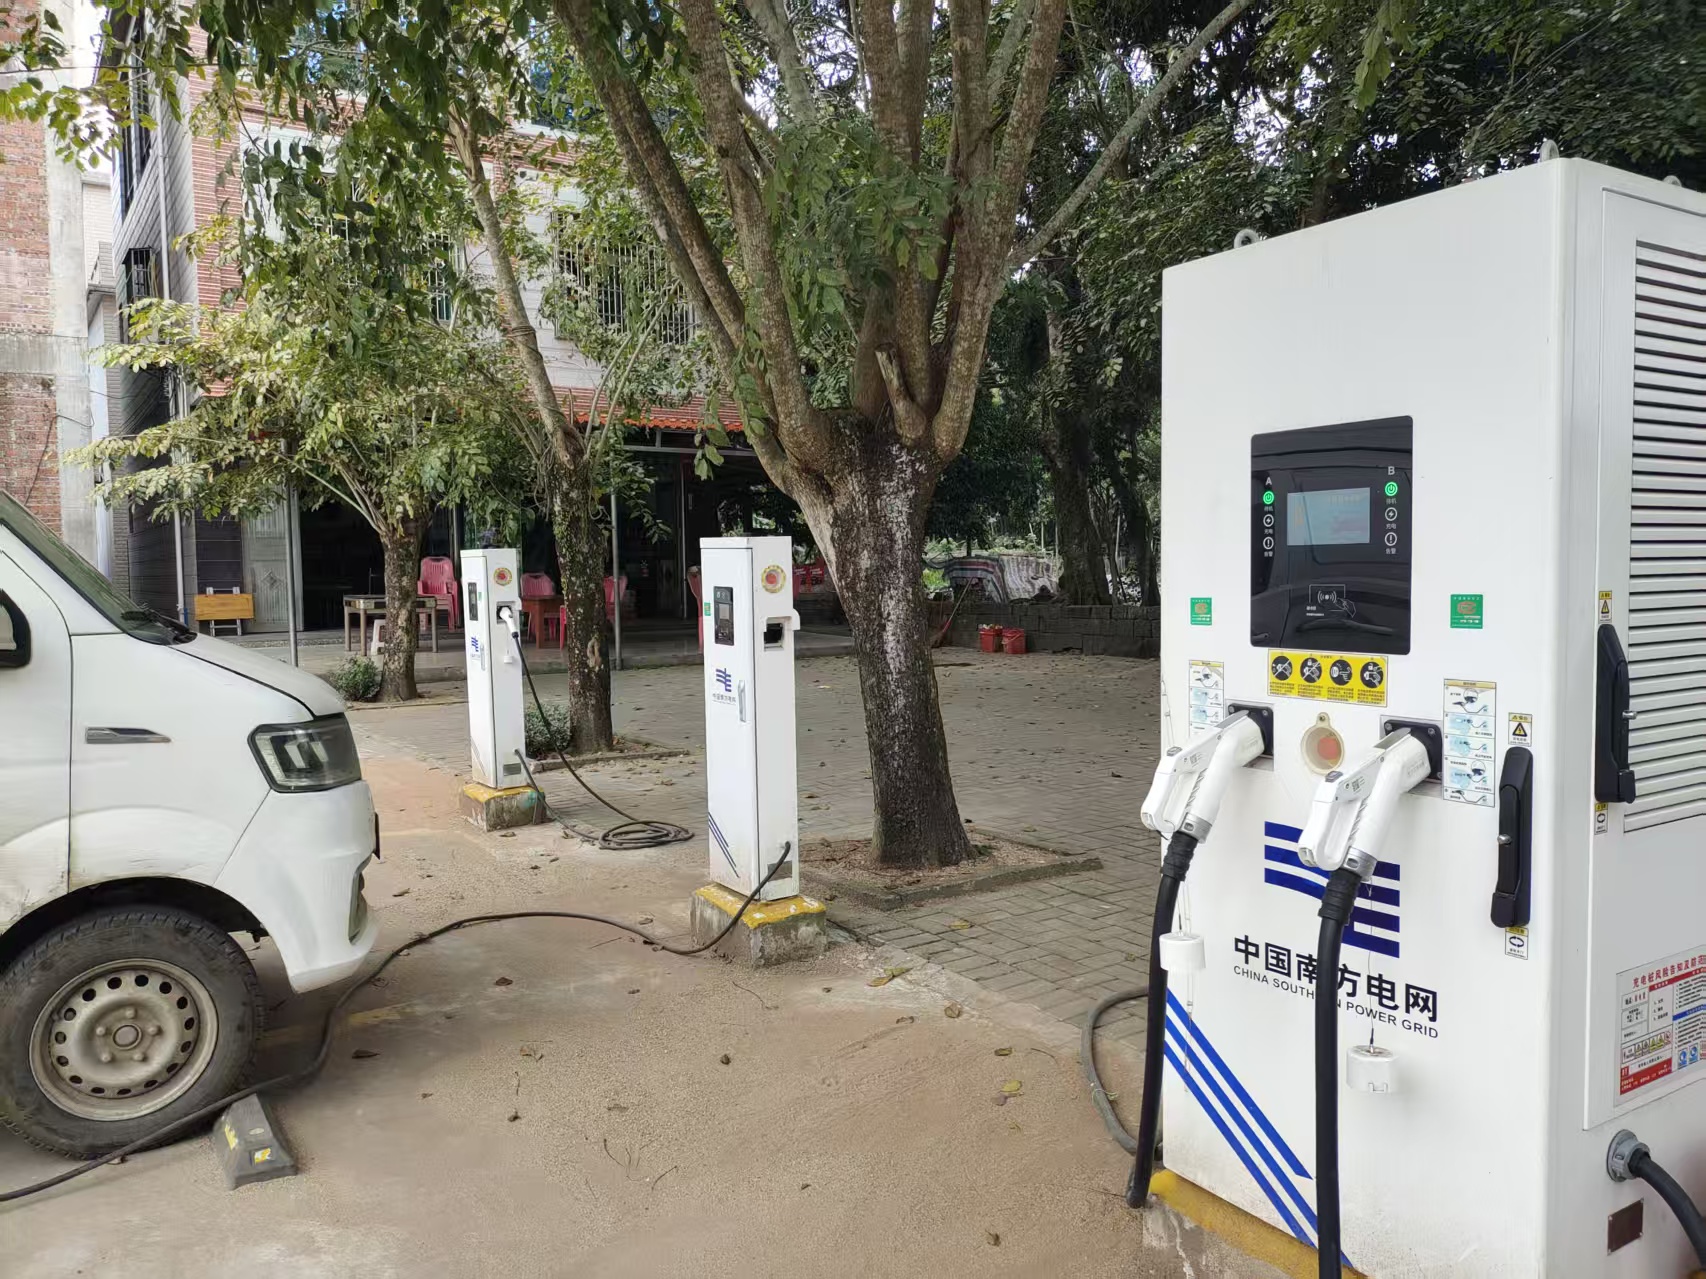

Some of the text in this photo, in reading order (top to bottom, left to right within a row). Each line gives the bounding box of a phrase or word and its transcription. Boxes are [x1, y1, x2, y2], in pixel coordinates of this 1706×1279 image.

[1265, 477, 1273, 486] A
[1387, 466, 1395, 476] B
[1234, 934, 1438, 1023] 中国南方电网
[1233, 965, 1439, 1039] CHINA SOUTHN POWER GRID
